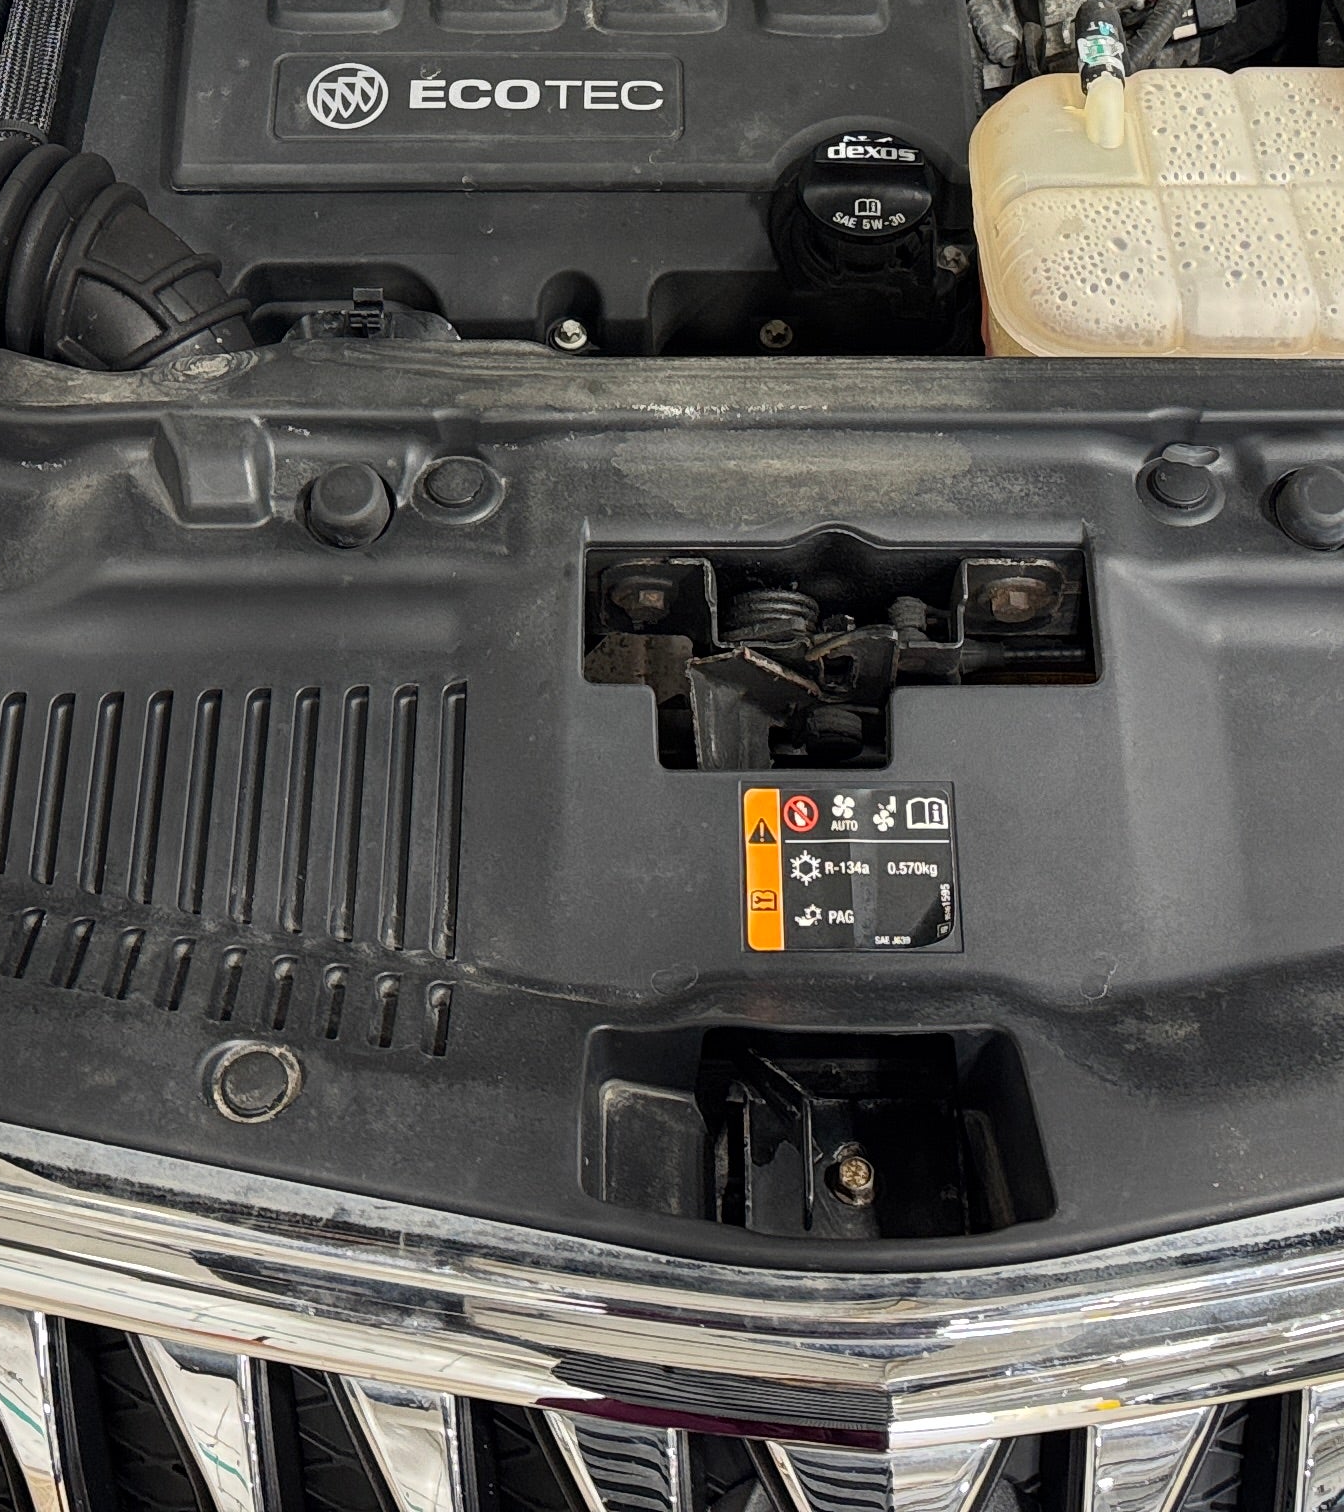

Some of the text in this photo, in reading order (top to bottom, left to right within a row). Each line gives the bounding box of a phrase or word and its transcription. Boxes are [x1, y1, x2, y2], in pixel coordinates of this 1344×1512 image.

[409, 79, 664, 111] ECOTEC
[827, 142, 919, 162] dexos
[832, 212, 906, 230] SAE 5W-30
[831, 820, 859, 832] AUTO
[825, 862, 938, 878] R-134a 0.570kg
[828, 910, 855, 924] PAG
[874, 935, 891, 945] SAE
